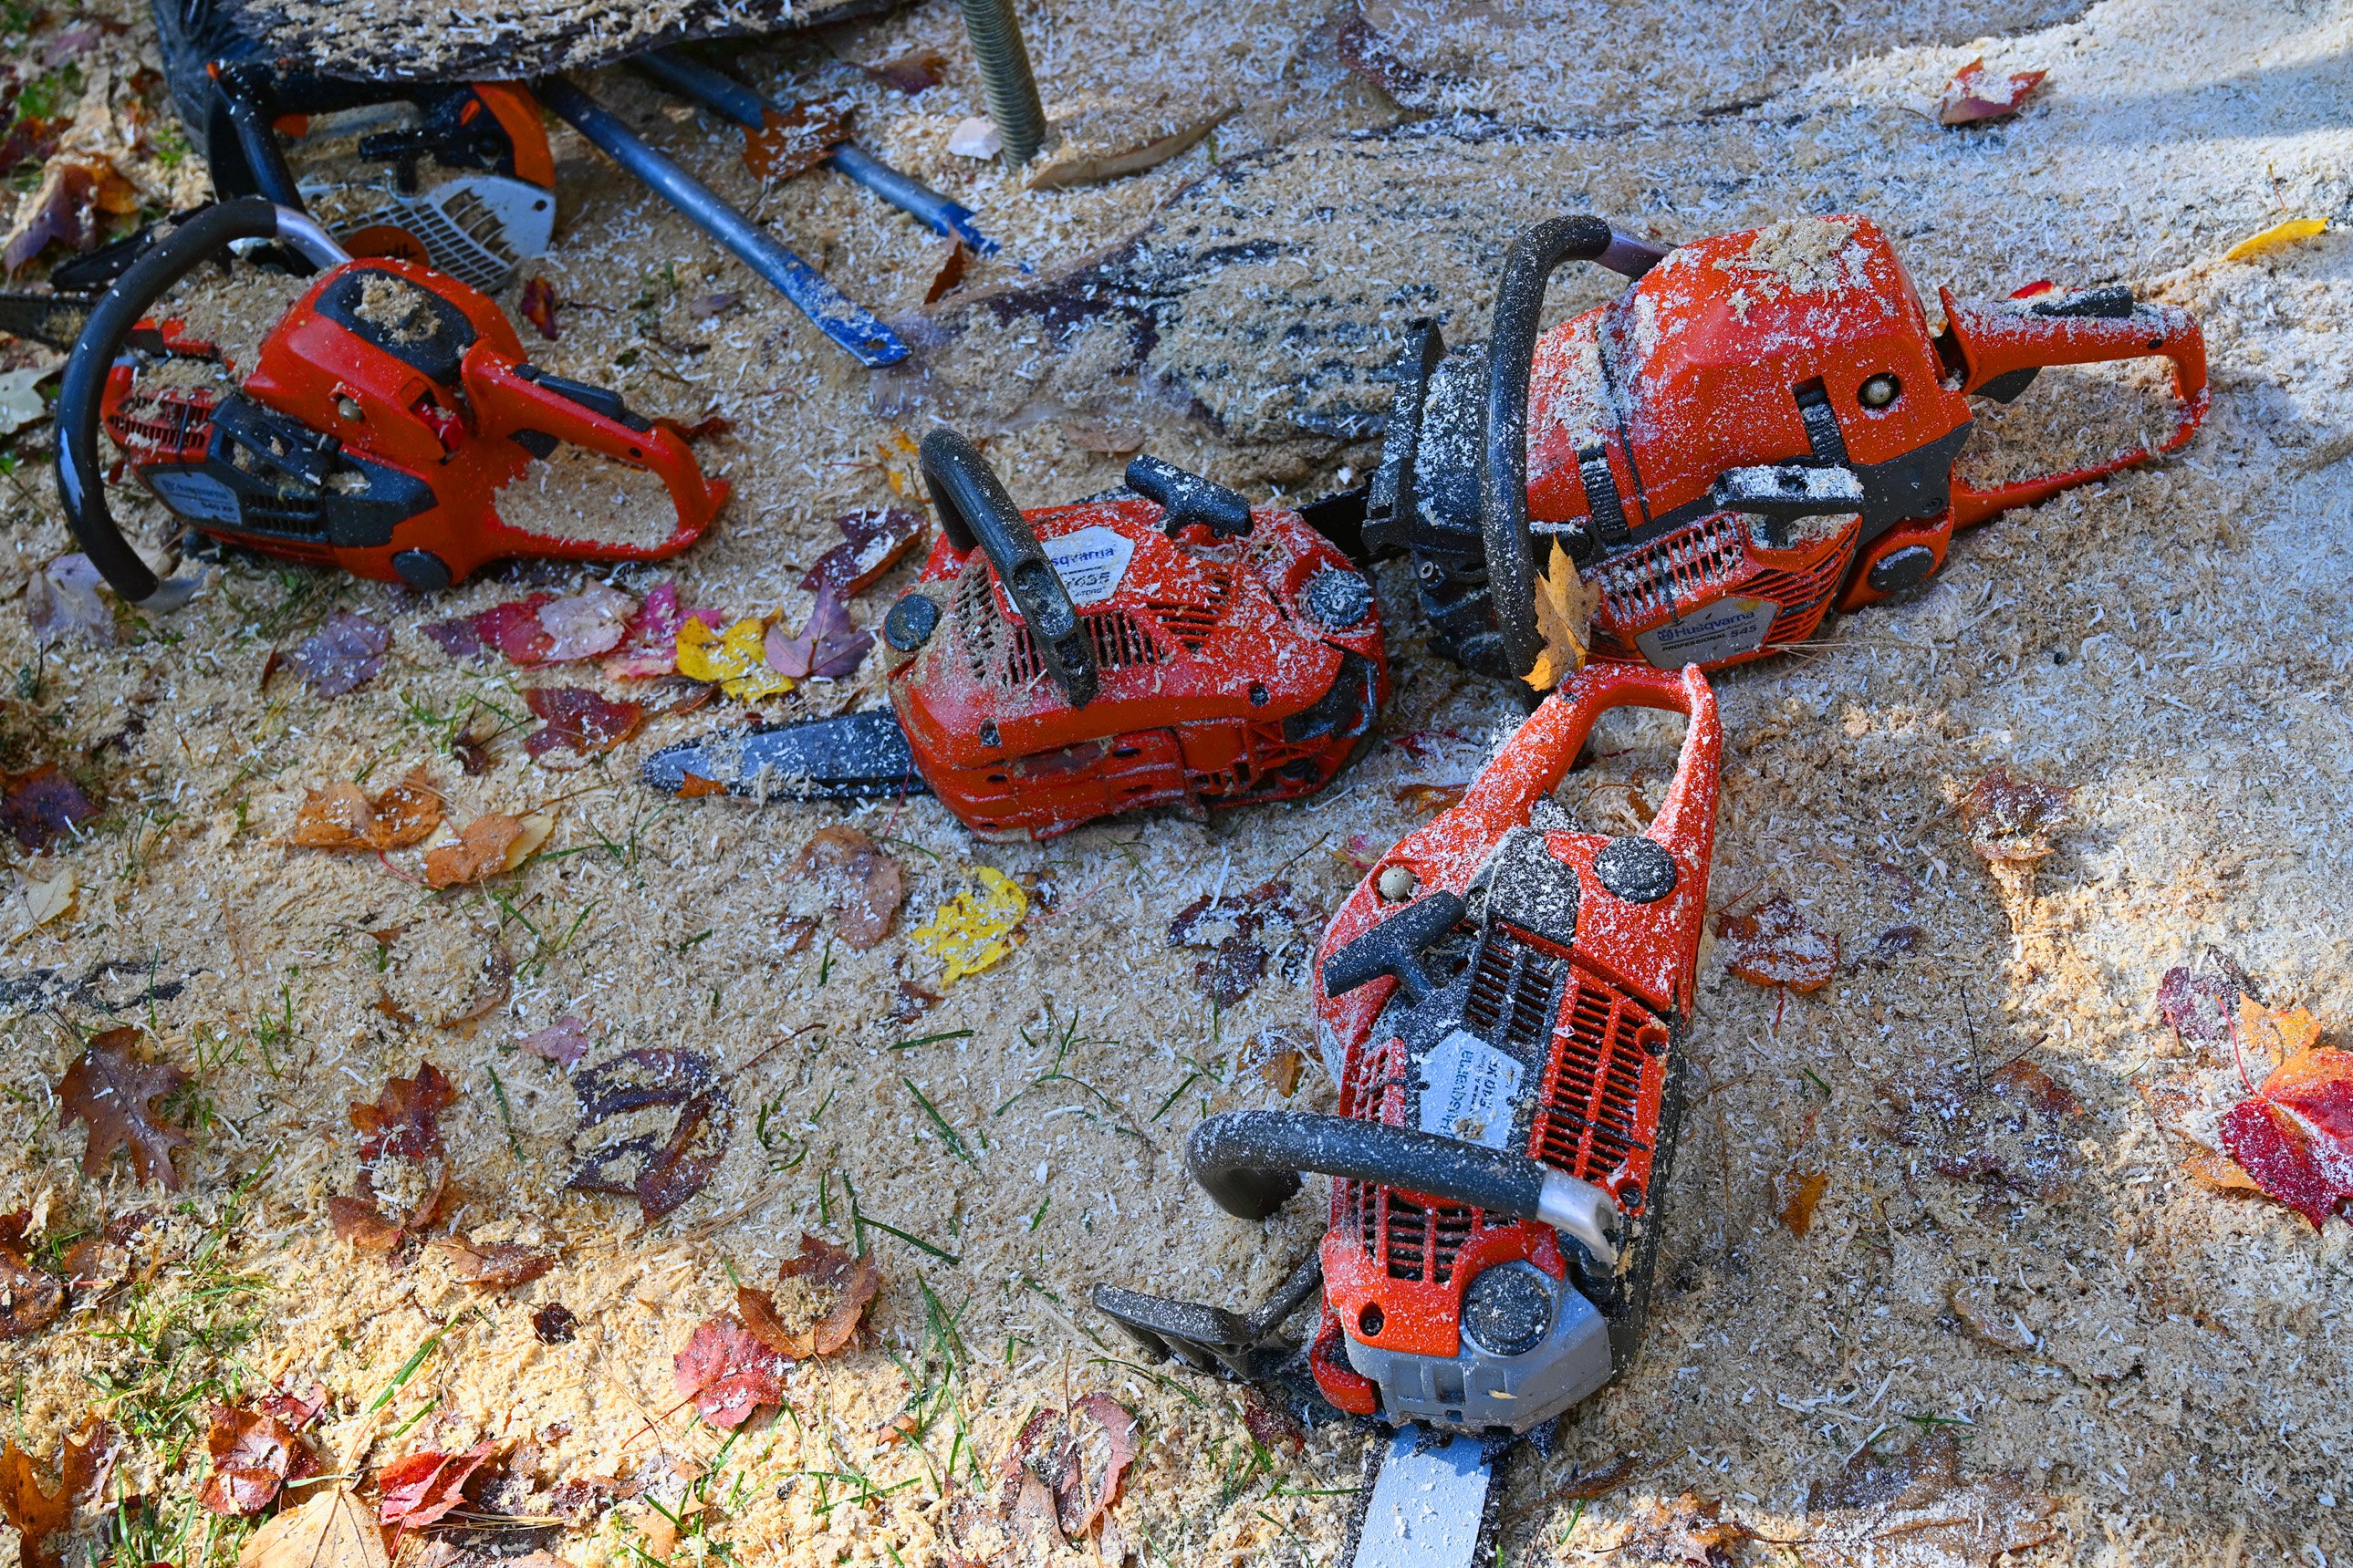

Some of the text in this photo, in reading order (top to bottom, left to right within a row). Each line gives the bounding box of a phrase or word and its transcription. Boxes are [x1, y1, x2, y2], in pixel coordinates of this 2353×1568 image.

[1050, 547, 1115, 567] sqvarna
[1674, 610, 1755, 638] Husqvarna
[1731, 624, 1758, 639] 545
[1661, 633, 1727, 652] PROFESSIONAL
[1440, 1050, 1474, 1133] Husqvarna
